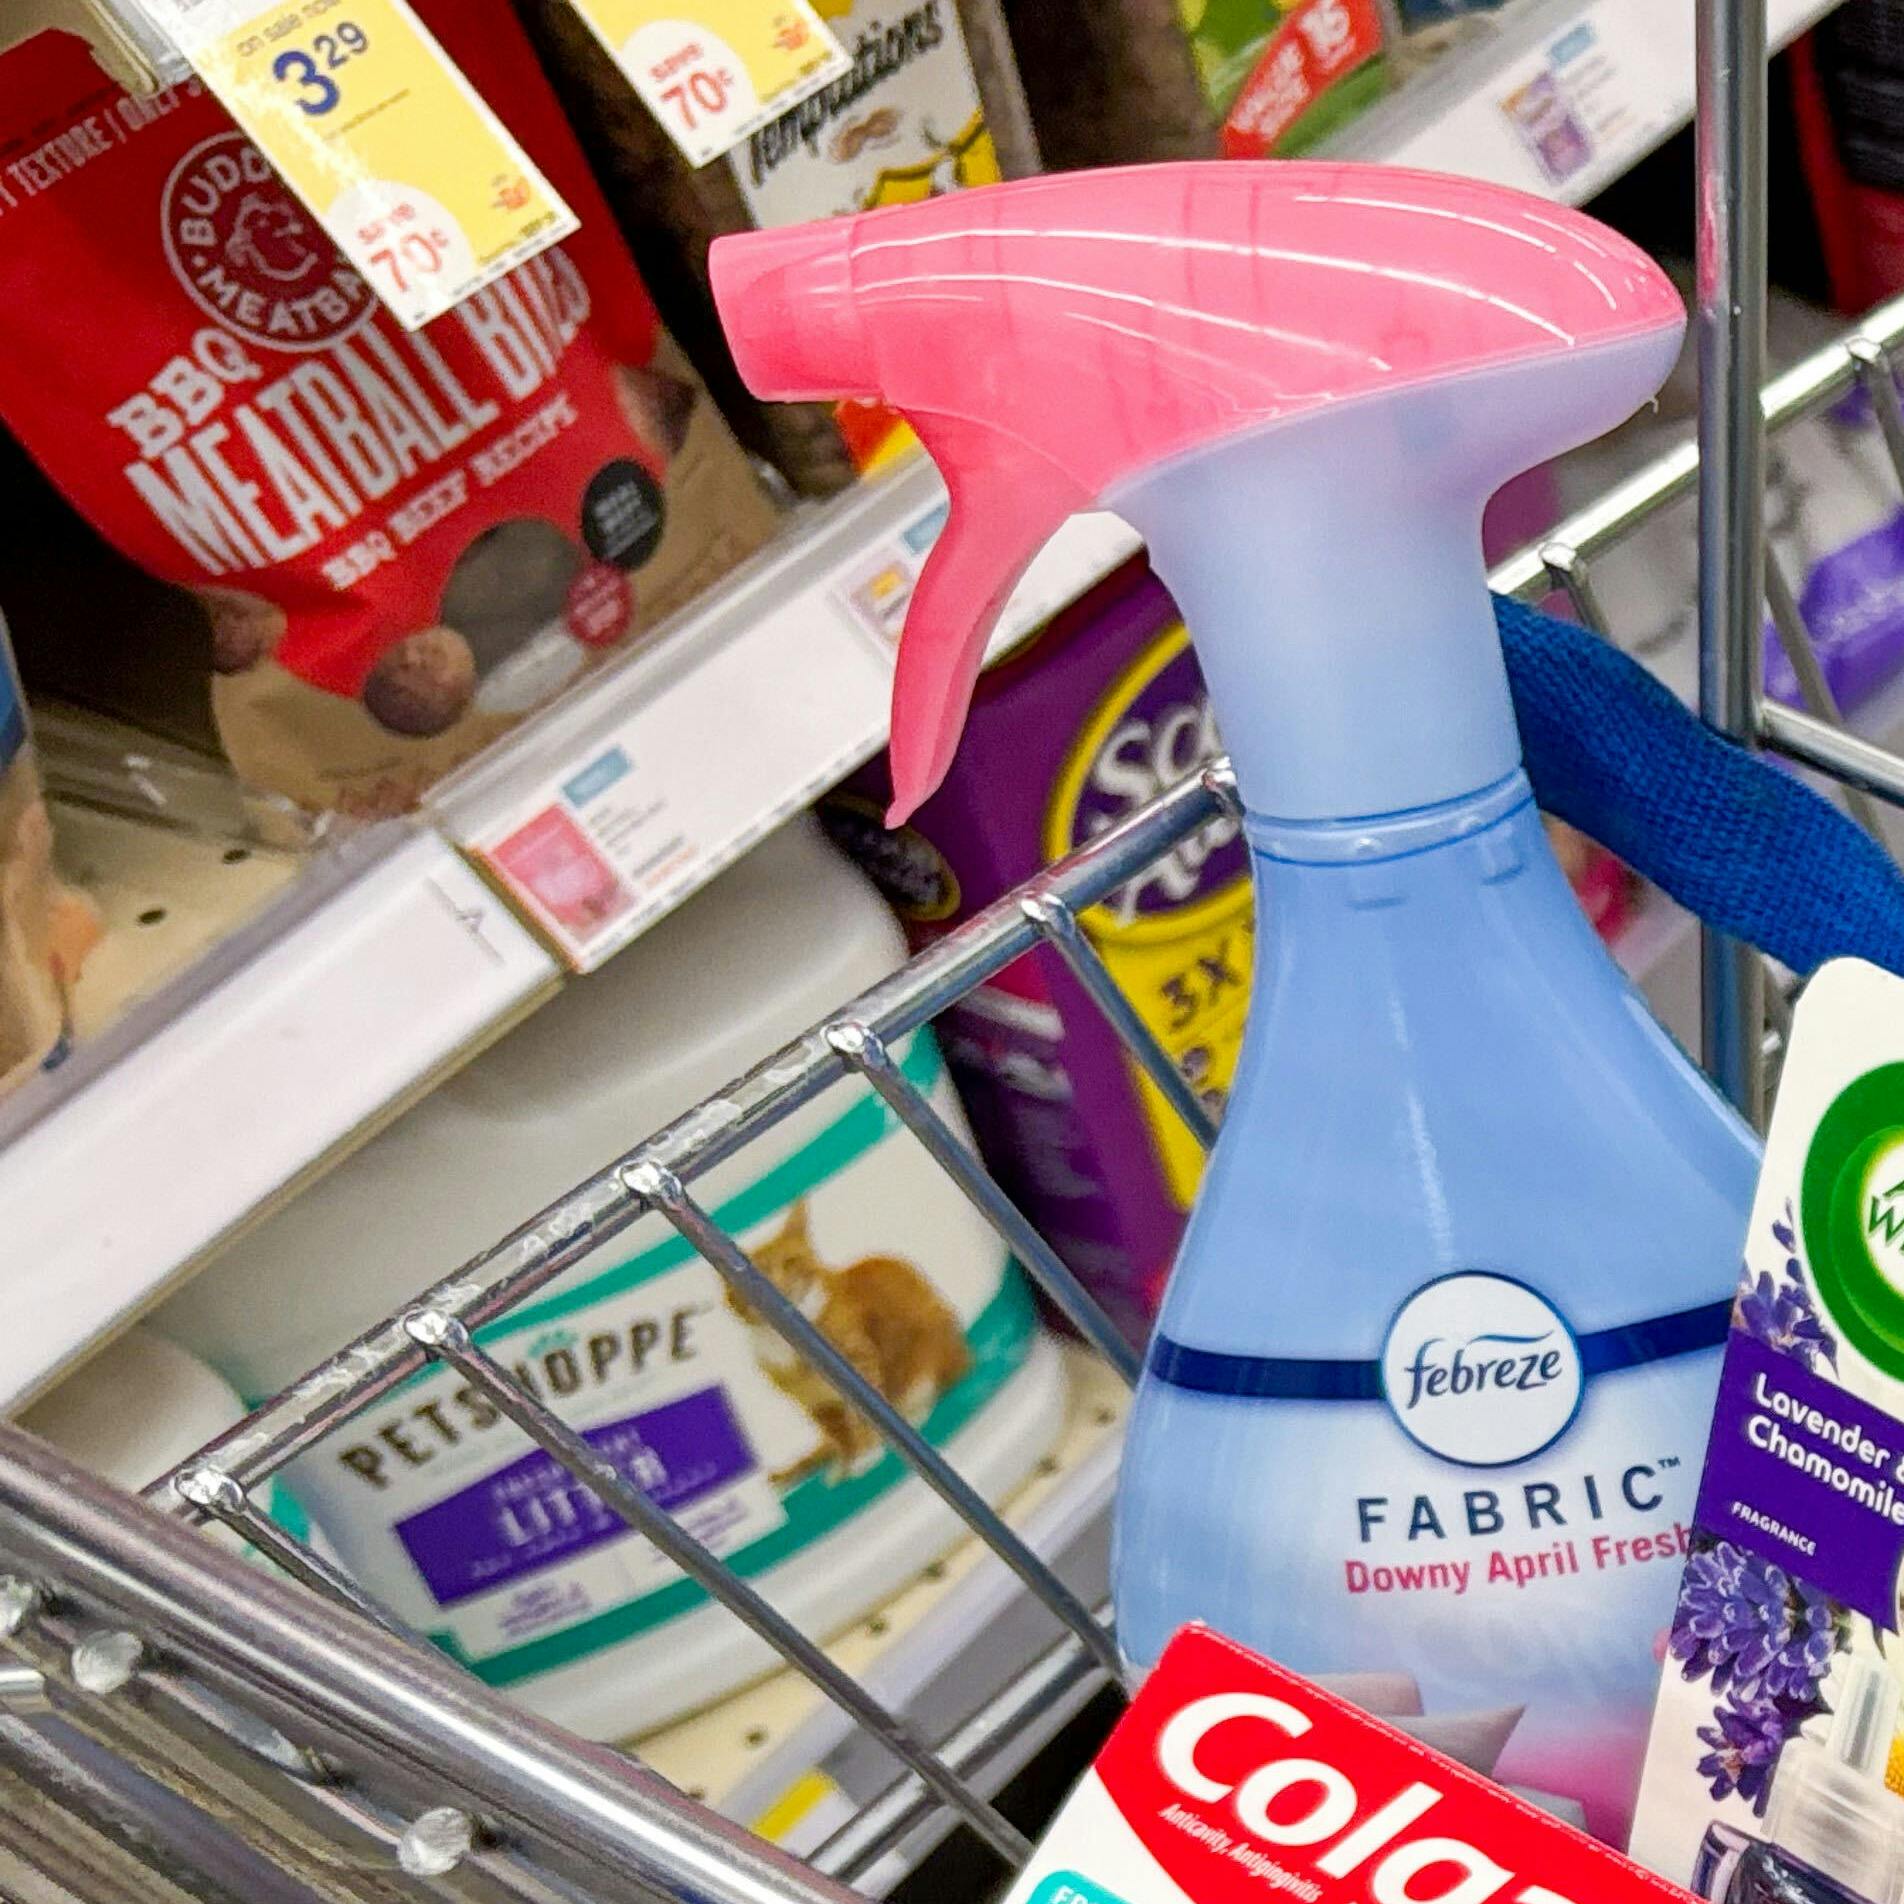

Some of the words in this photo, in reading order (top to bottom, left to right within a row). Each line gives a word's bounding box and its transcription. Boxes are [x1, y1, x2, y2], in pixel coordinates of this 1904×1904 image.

[106, 329, 263, 459] BBQ
[123, 320, 499, 576] MEATBALL
[1405, 1334, 1563, 1409] febreze
[1757, 1373, 1890, 1471] Lavender
[1345, 1555, 1471, 1595] Downy
[1487, 1540, 1580, 1587] April
[1592, 1522, 1692, 1570] Fresh
[1732, 1501, 1817, 1557] FRAGRANCE
[1157, 1802, 1231, 1856] Anticavity,
